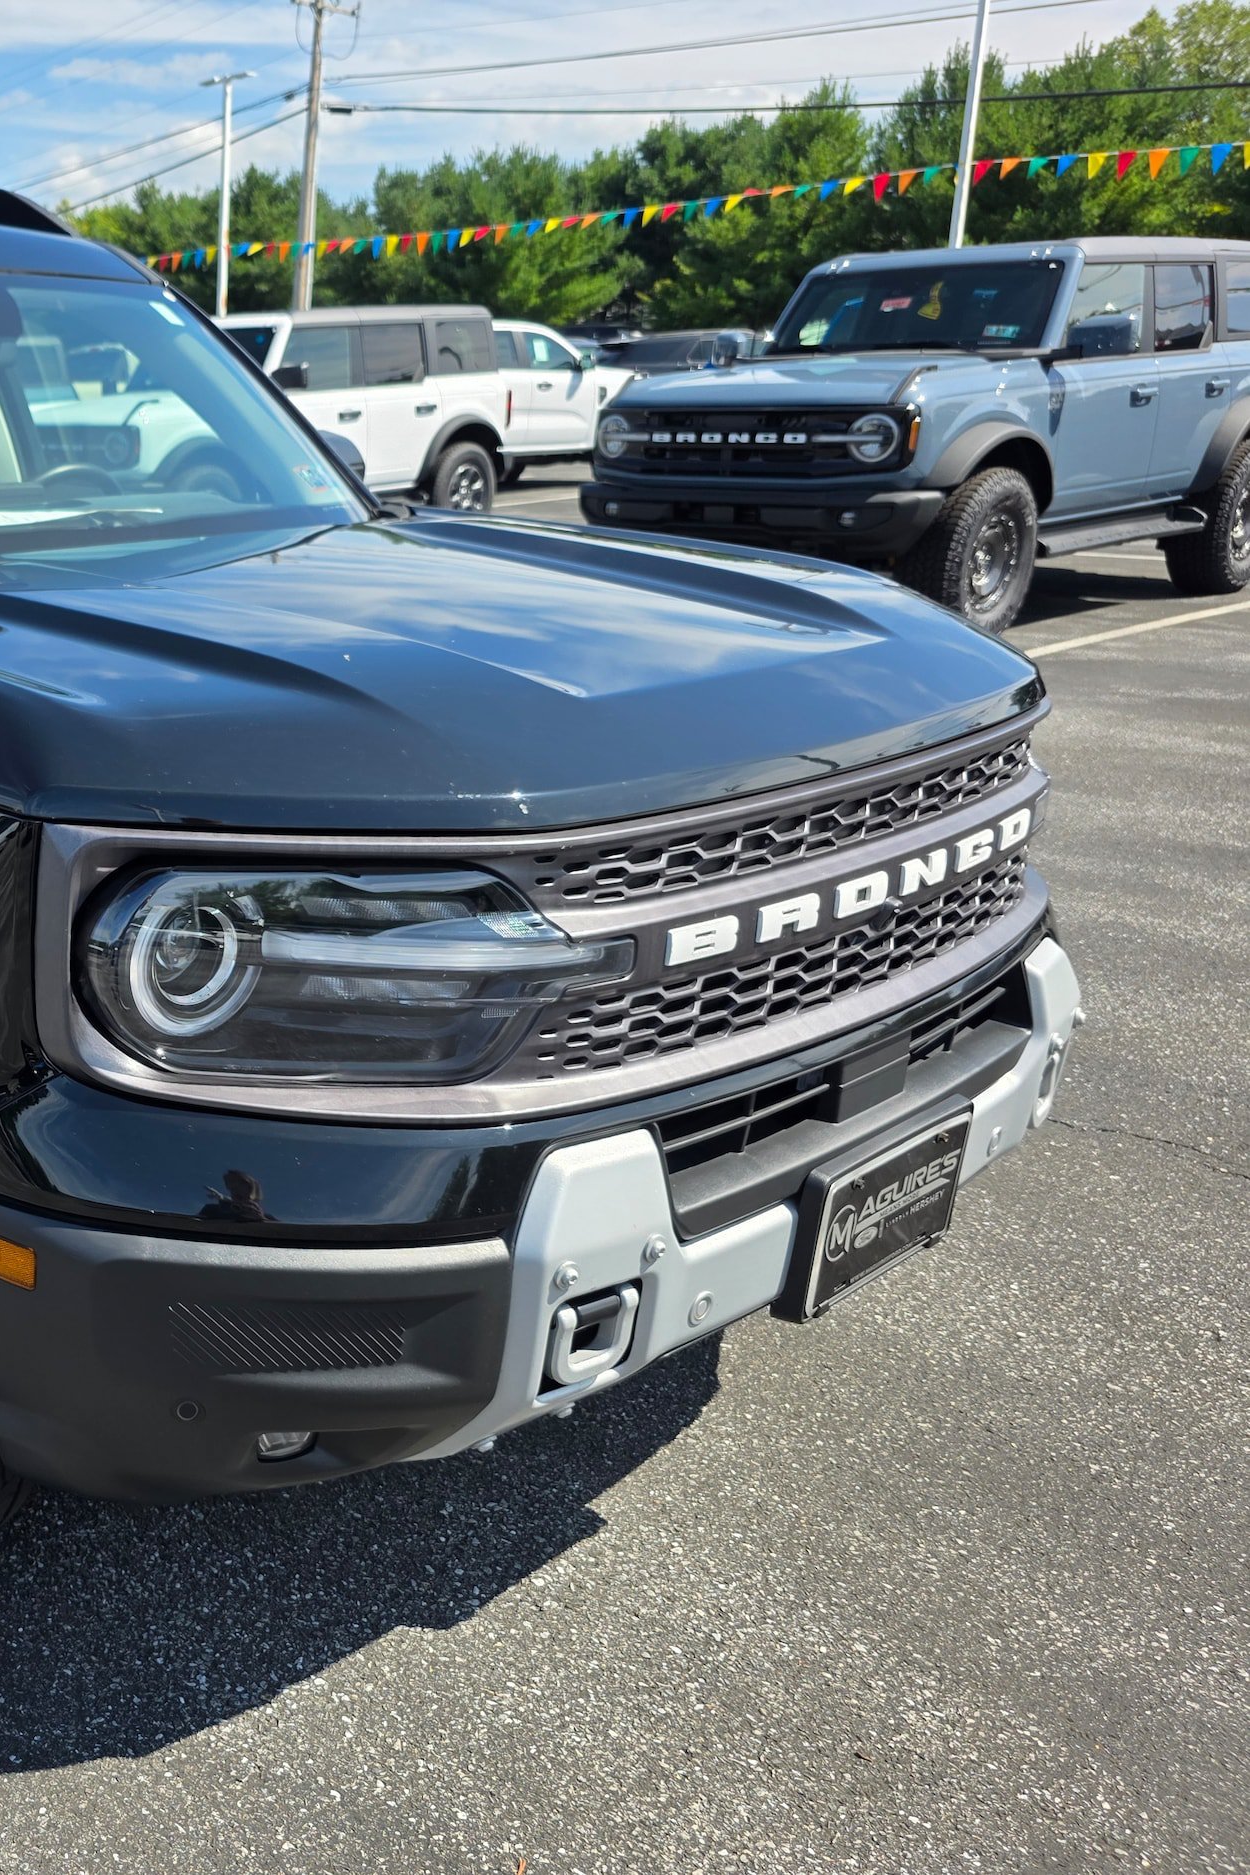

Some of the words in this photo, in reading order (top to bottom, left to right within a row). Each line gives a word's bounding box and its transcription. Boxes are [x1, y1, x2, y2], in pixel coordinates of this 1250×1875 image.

[651, 431, 809, 445] BRONCO
[664, 808, 1031, 967] BRONCO
[910, 1189, 946, 1215] HERSHEY
